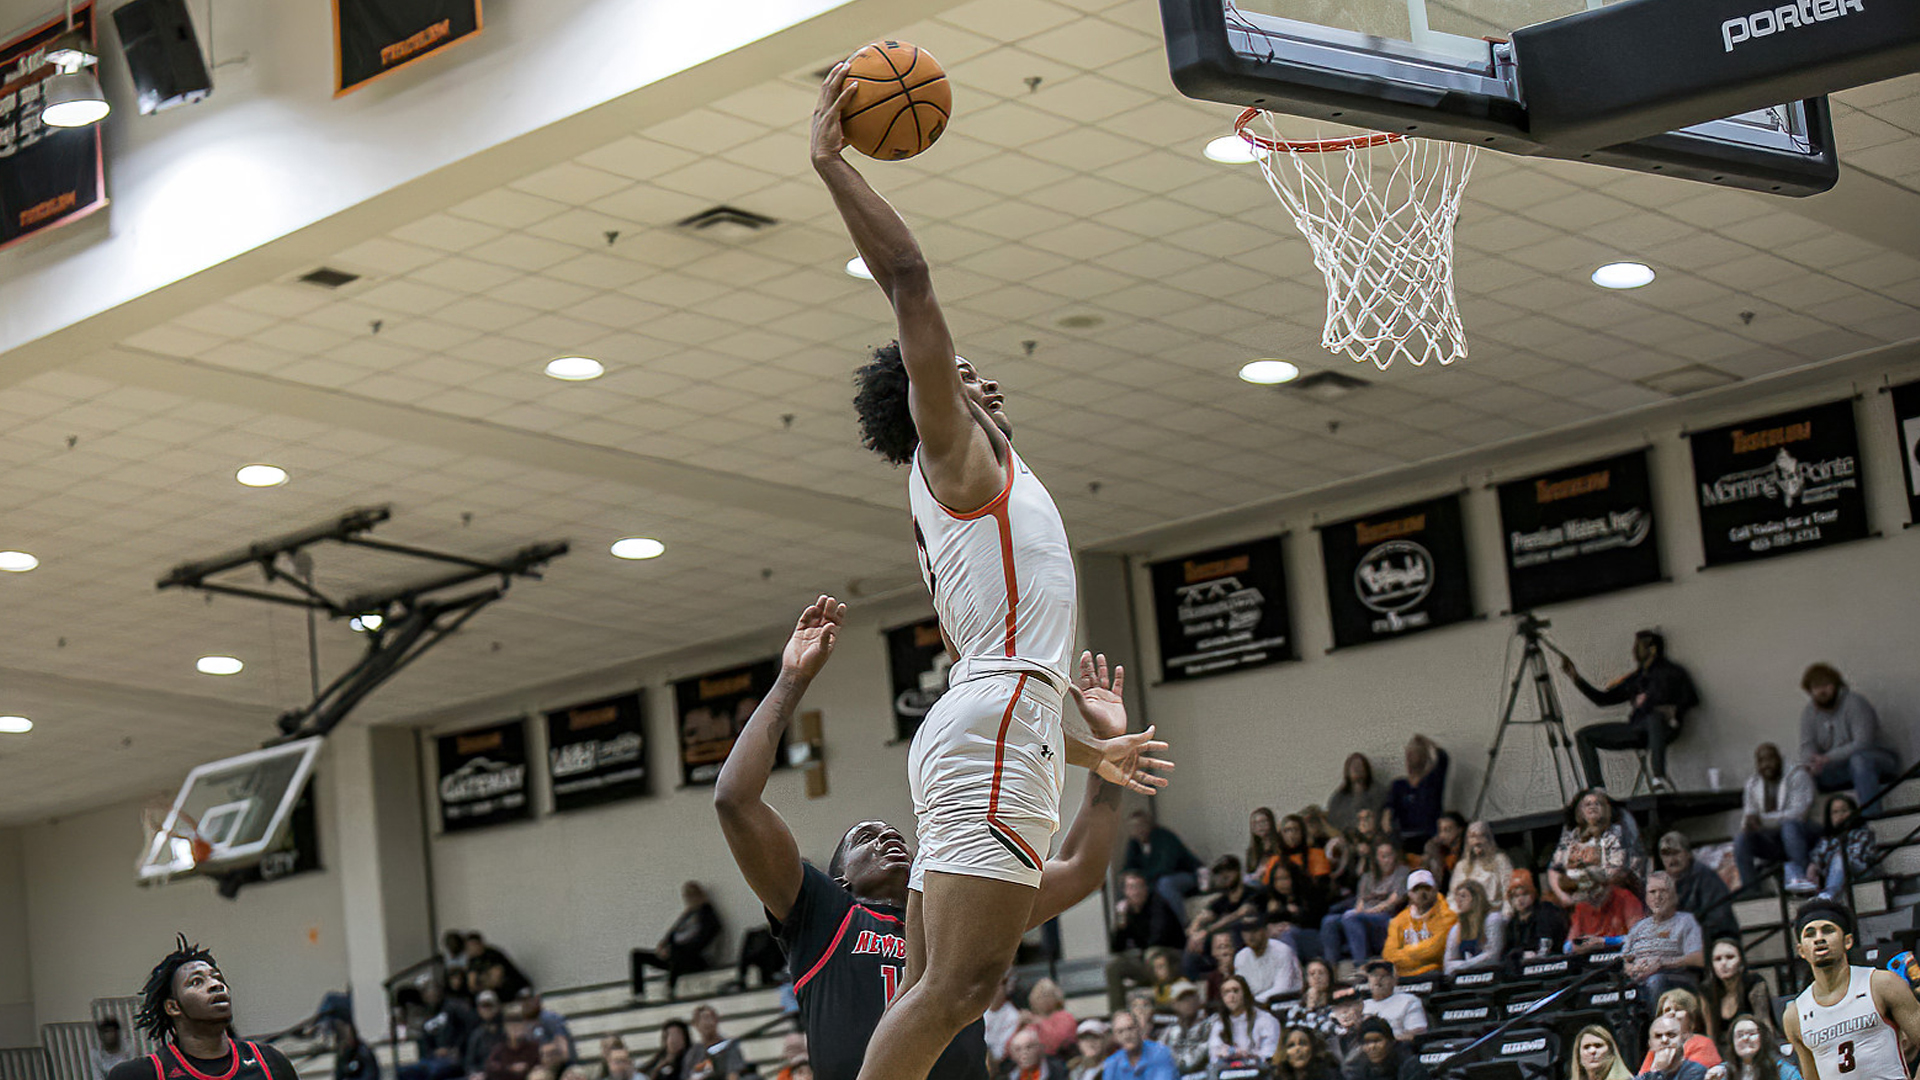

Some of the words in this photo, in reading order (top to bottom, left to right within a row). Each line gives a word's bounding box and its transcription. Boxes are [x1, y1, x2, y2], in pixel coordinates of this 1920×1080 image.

[881, 965, 906, 1009] 1
[1804, 1012, 1878, 1048] TUSCULUM
[1838, 1040, 1856, 1073] 3
